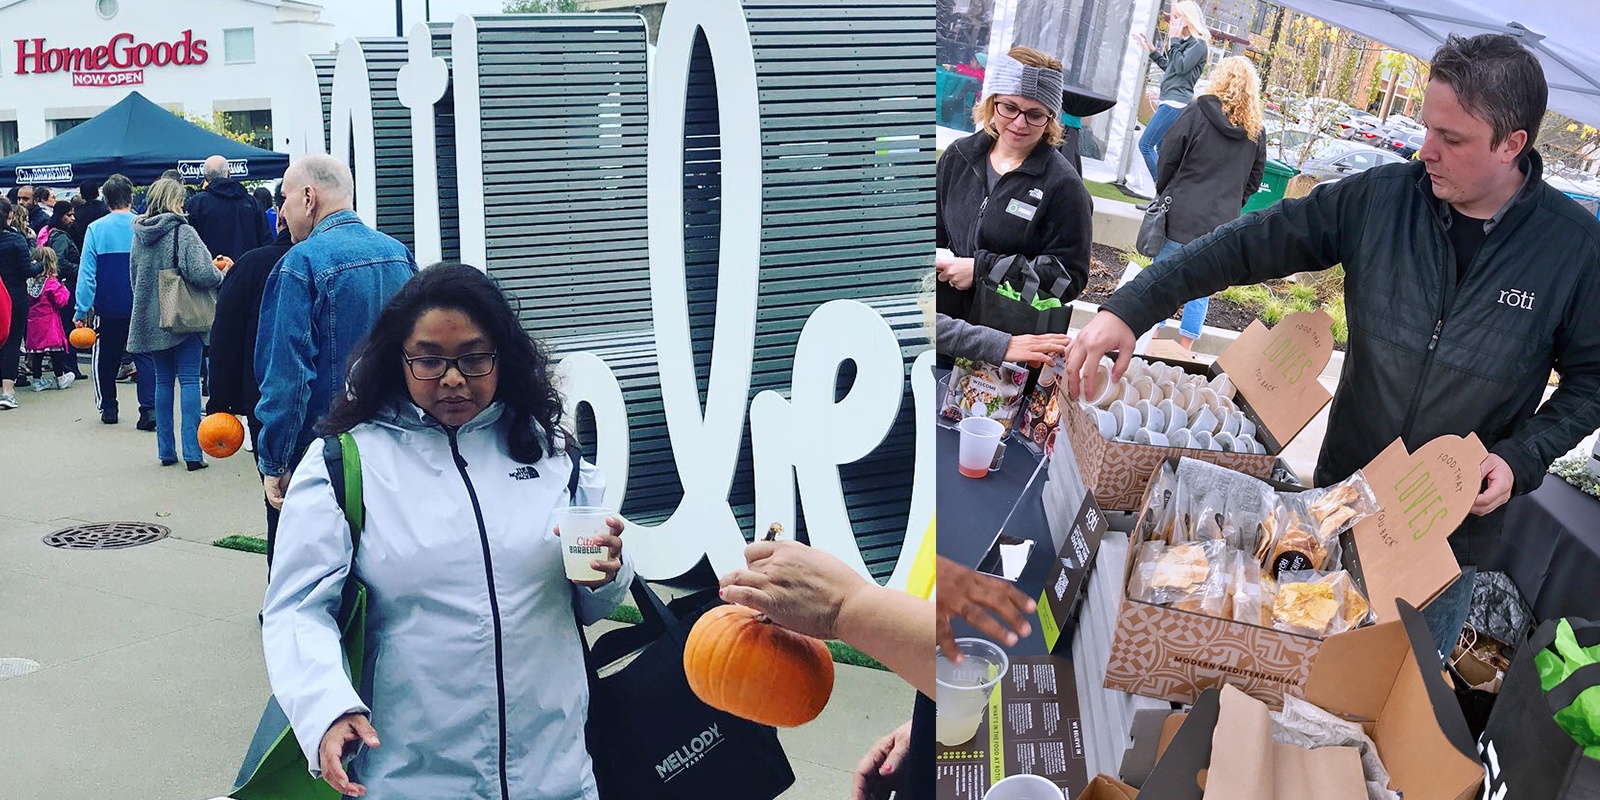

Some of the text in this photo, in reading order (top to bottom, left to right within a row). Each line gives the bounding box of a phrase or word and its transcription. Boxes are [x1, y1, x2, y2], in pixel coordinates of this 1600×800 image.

[13, 29, 209, 75] HomeGoods
[74, 71, 143, 85] NOW OPEN
[1295, 323, 1321, 349] FOOD THAT
[1263, 332, 1314, 385] LOVES
[973, 379, 997, 391] WELCOME
[1437, 453, 1463, 493] FOOD THAT
[1393, 460, 1448, 541] LOVES
[1377, 507, 1386, 528] YOU
[569, 545, 602, 554] BARBEQUE
[1174, 656, 1300, 686] MODERN MEDITERRANEAN
[655, 722, 721, 778] MELLODY
[685, 752, 705, 768] FARM
[993, 757, 1000, 766] AT
